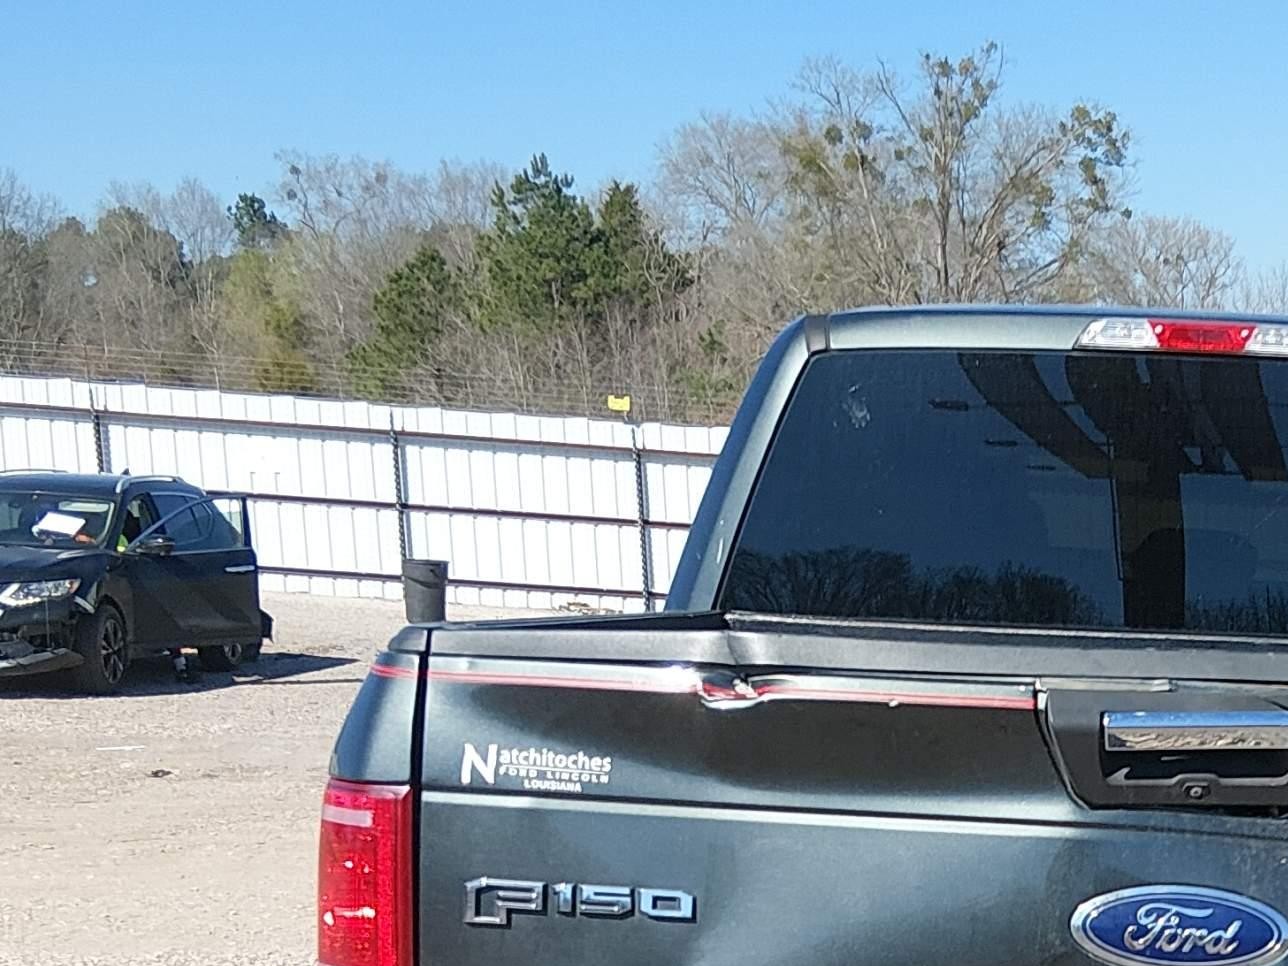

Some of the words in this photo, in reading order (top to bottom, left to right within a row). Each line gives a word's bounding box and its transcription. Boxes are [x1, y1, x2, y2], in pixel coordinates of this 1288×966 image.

[460, 742, 612, 785] Natchitoches
[499, 767, 537, 778] FORD
[546, 770, 609, 784] LINCOLN
[523, 779, 582, 792] LOUISIANA
[1123, 902, 1243, 955] Ford
